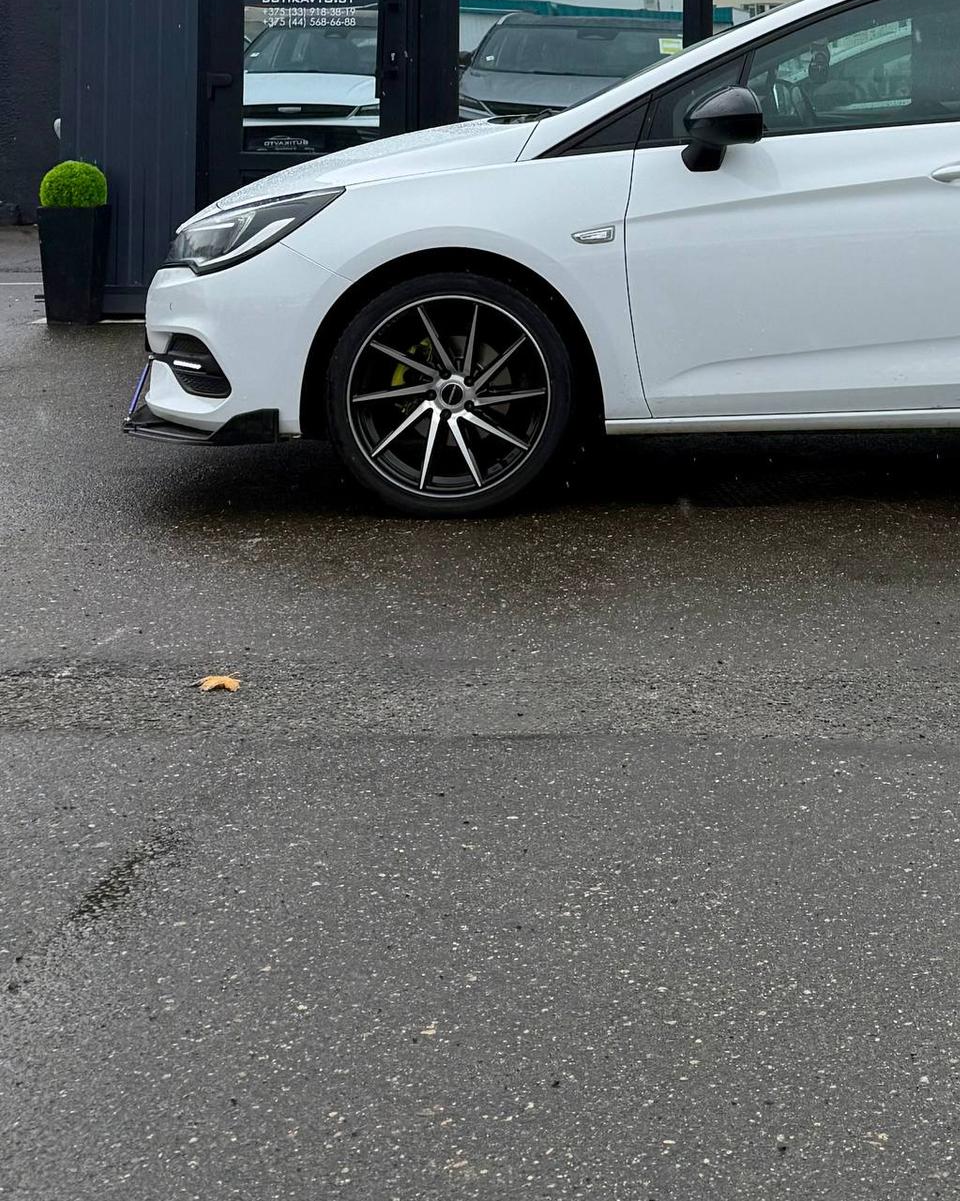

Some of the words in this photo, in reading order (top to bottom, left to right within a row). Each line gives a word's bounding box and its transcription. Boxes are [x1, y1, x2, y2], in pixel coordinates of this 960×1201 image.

[263, 7, 286, 17] +375
[263, 17, 286, 27] +375
[288, 17, 307, 28] (44)
[309, 17, 356, 27] 568-66-88
